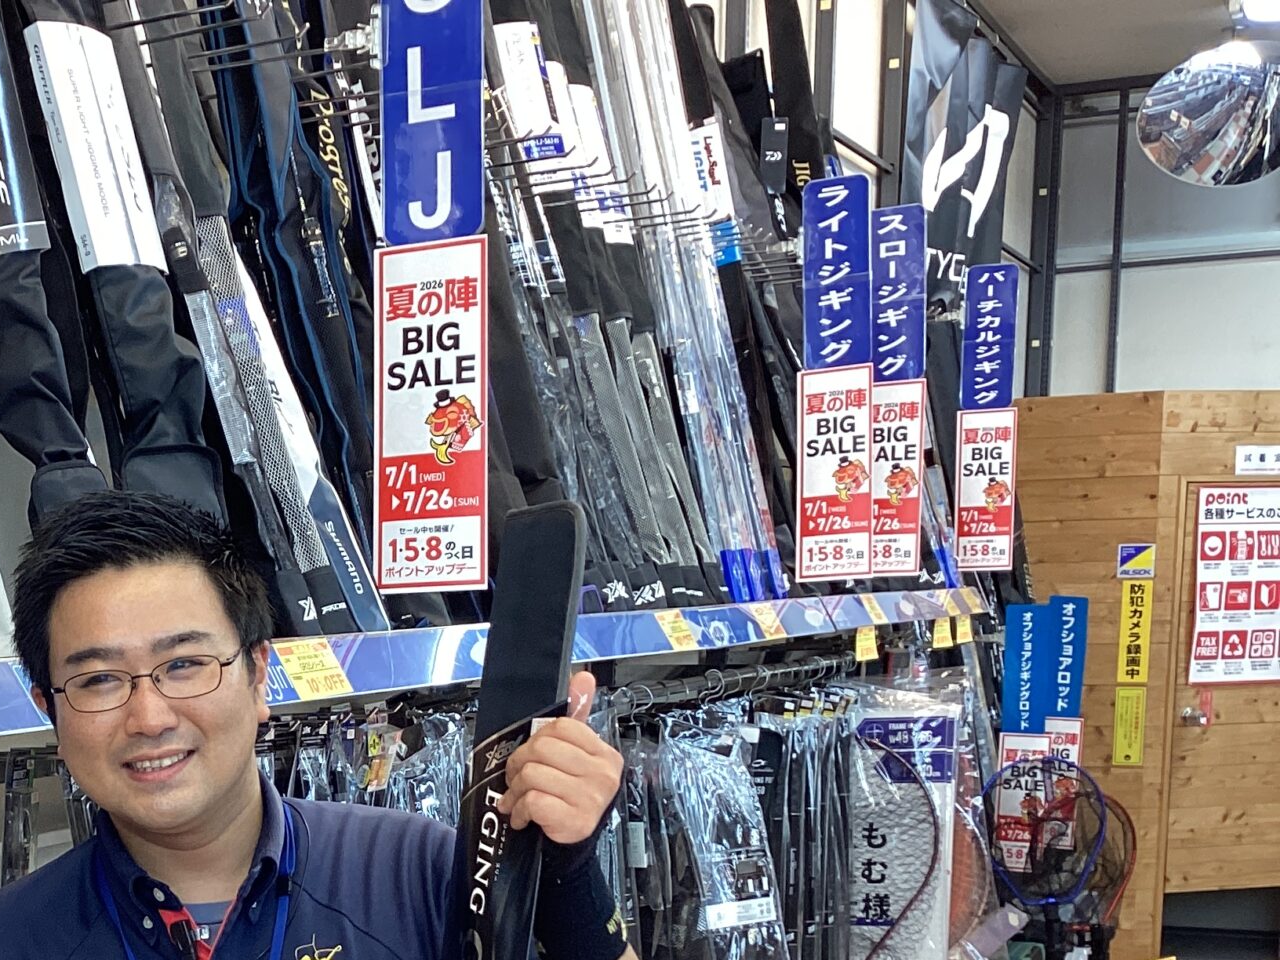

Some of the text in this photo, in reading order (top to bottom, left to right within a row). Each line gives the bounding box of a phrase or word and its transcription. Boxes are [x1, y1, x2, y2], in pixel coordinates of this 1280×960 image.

[33, 43, 52, 105] GRAPPLER
[403, 0, 455, 229] LJ
[76, 105, 90, 137] LIGHT
[96, 179, 110, 218] MODEL
[420, 280, 444, 291] 2026
[817, 184, 854, 363] ライトジギング
[385, 276, 478, 321] 夏の陣
[877, 214, 910, 376] スロージギング
[402, 321, 461, 356] BIG
[973, 270, 1006, 405] バーチカルジギング
[387, 354, 476, 392] SALE
[805, 388, 867, 415] 夏の陣
[816, 416, 856, 436] BIG
[873, 426, 908, 443] BIG
[963, 426, 1011, 444] 夏の陣
[806, 435, 866, 457] SALE
[874, 444, 917, 462] ALE
[971, 447, 1002, 461] BIG
[385, 462, 418, 488] 7/1
[963, 462, 1010, 476] SALE
[402, 488, 453, 514] 7/26
[805, 502, 827, 517] 7/1
[1205, 493, 1249, 507] point
[817, 516, 851, 530] 7/26
[324, 520, 364, 595] SHIMANO
[384, 563, 478, 579] ポイントアップデー
[1119, 568, 1152, 577] ALSOK
[1125, 583, 1146, 681] 防犯カメラ録画中
[1200, 636, 1217, 647] TAX
[1056, 602, 1077, 713] オフショアロッド
[1196, 647, 1218, 657] FREE
[1019, 611, 1034, 731] オフショアジギングロッド
[1052, 733, 1079, 747] の陣
[1010, 765, 1038, 779] BIG
[1002, 779, 1045, 792] SALE
[469, 786, 504, 916] EGING
[861, 822, 891, 920] もむ様
